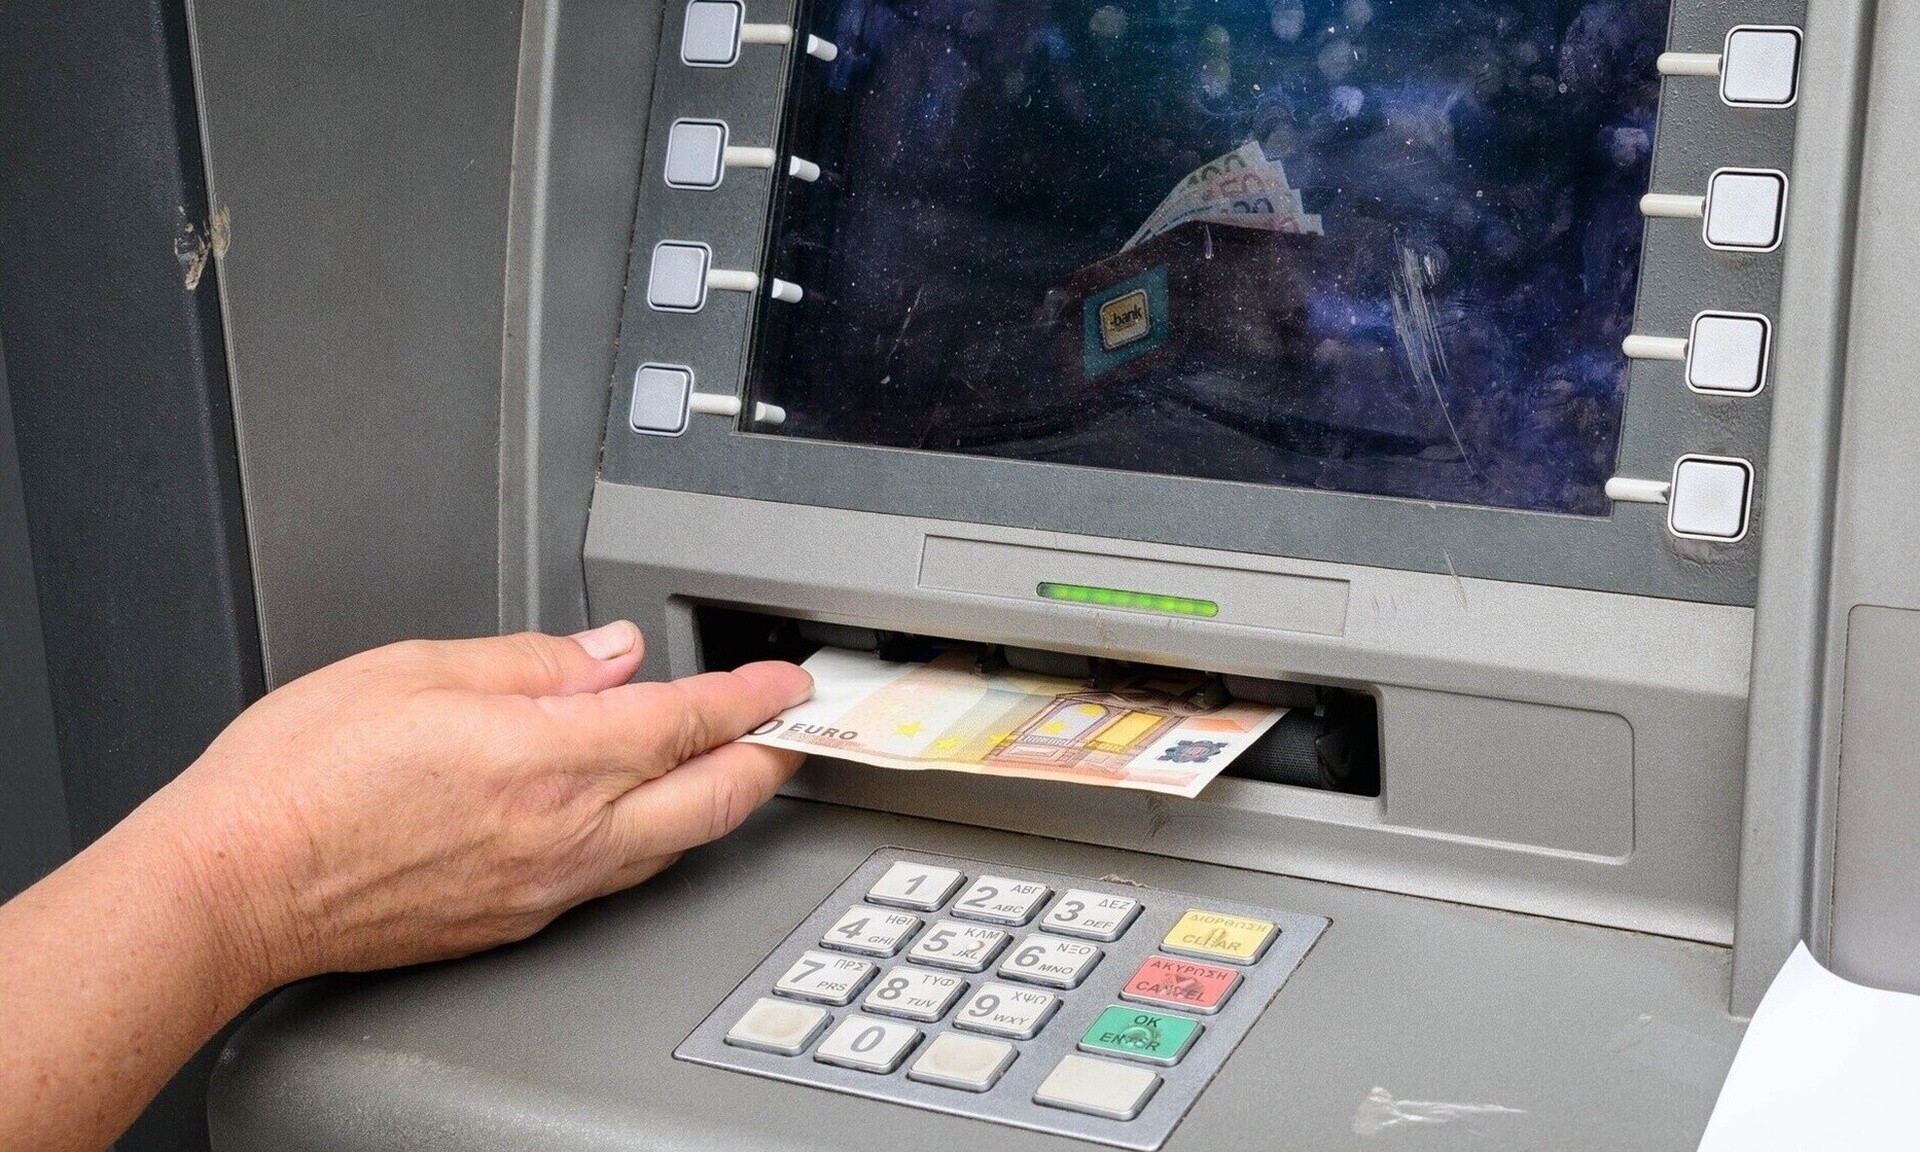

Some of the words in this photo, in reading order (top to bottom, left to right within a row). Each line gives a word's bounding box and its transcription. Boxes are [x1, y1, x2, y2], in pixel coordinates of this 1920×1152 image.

[788, 722, 859, 740] EURO
[904, 874, 928, 895] 1
[963, 886, 999, 908] 2
[991, 904, 1025, 914] ABC
[1054, 900, 1085, 922] 3
[837, 917, 871, 939] 4
[1083, 919, 1115, 929] DEF
[868, 936, 895, 946] GHI
[922, 929, 958, 952] 5
[952, 950, 978, 960] JKL
[1014, 945, 1047, 967] 6
[789, 959, 827, 983] 7
[1038, 963, 1074, 975] MNO
[816, 980, 848, 992] PRS
[876, 977, 910, 1000] 8
[906, 997, 938, 1008] TUV
[968, 994, 1001, 1017] 9
[993, 1013, 1030, 1026] WXY
[1133, 1014, 1162, 1028] OK
[850, 1025, 886, 1053] 0
[1099, 1031, 1160, 1051] ENER
